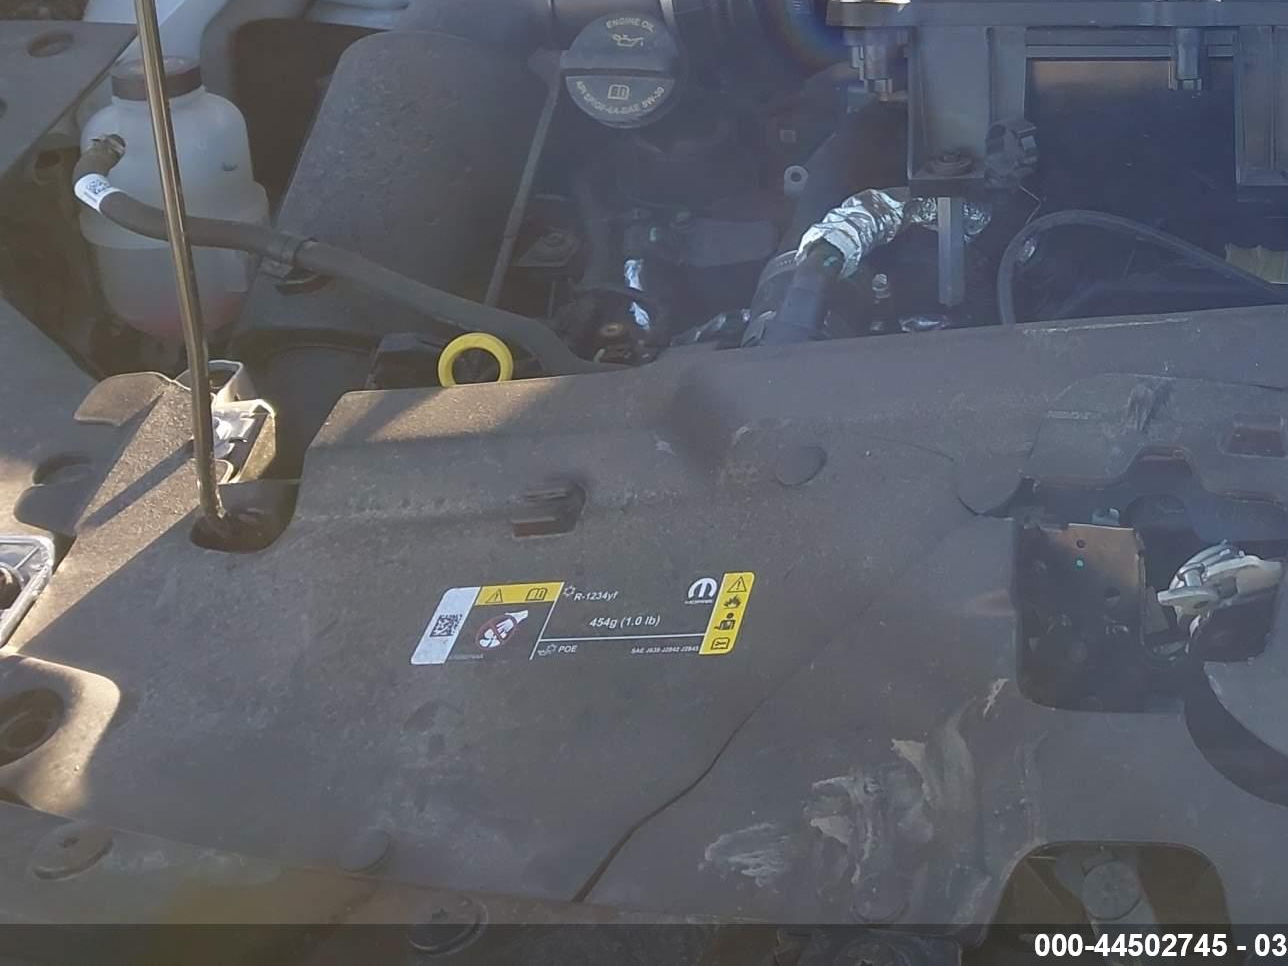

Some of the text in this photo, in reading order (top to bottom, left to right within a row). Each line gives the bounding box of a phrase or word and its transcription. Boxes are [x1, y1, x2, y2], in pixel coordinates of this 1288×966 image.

[606, 17, 641, 29] ENGINE
[573, 590, 620, 602] R-1234yf
[589, 615, 662, 629] 454g (1.0 lb)
[557, 645, 577, 654] POE
